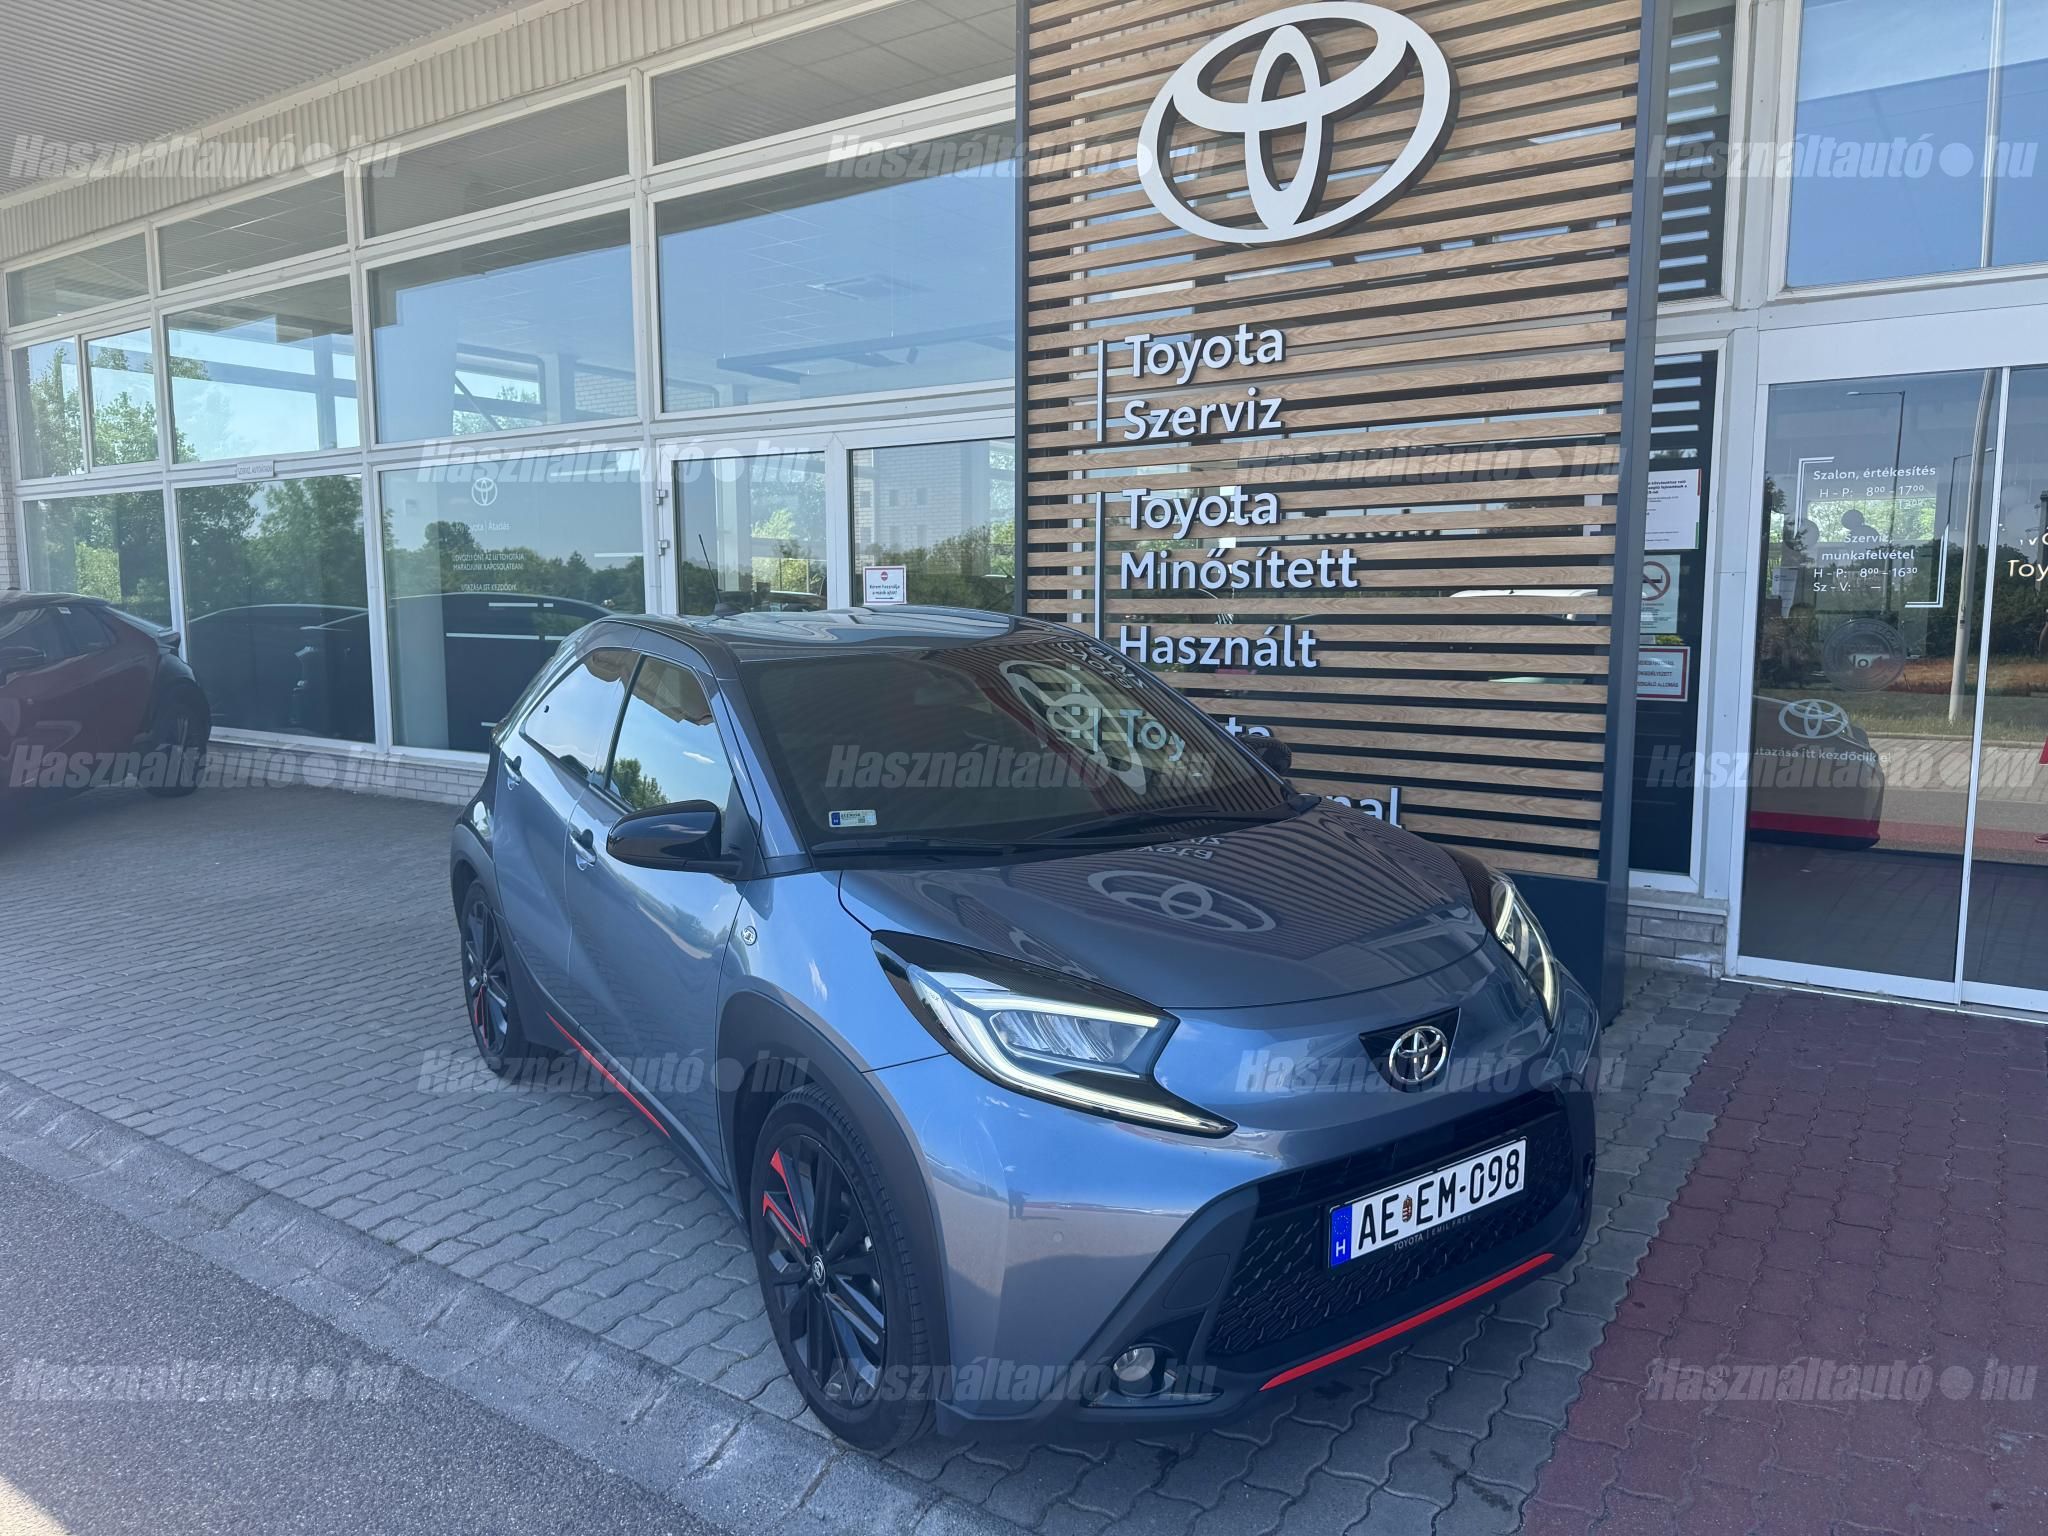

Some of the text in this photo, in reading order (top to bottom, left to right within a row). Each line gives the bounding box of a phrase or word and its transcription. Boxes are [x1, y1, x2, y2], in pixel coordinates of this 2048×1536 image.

[1125, 324, 1284, 385] Toyota
[1124, 387, 1283, 440] Szerviz
[1813, 465, 1936, 480] Szalon, értékesítés
[1122, 485, 1279, 540] Toyota
[1121, 547, 1359, 590] Minősített
[1821, 549, 1915, 561] munkafelvétel
[1120, 625, 1318, 668] Használt
[1335, 1239, 1346, 1257] H
[1393, 1233, 1424, 1252] TOYOTA
